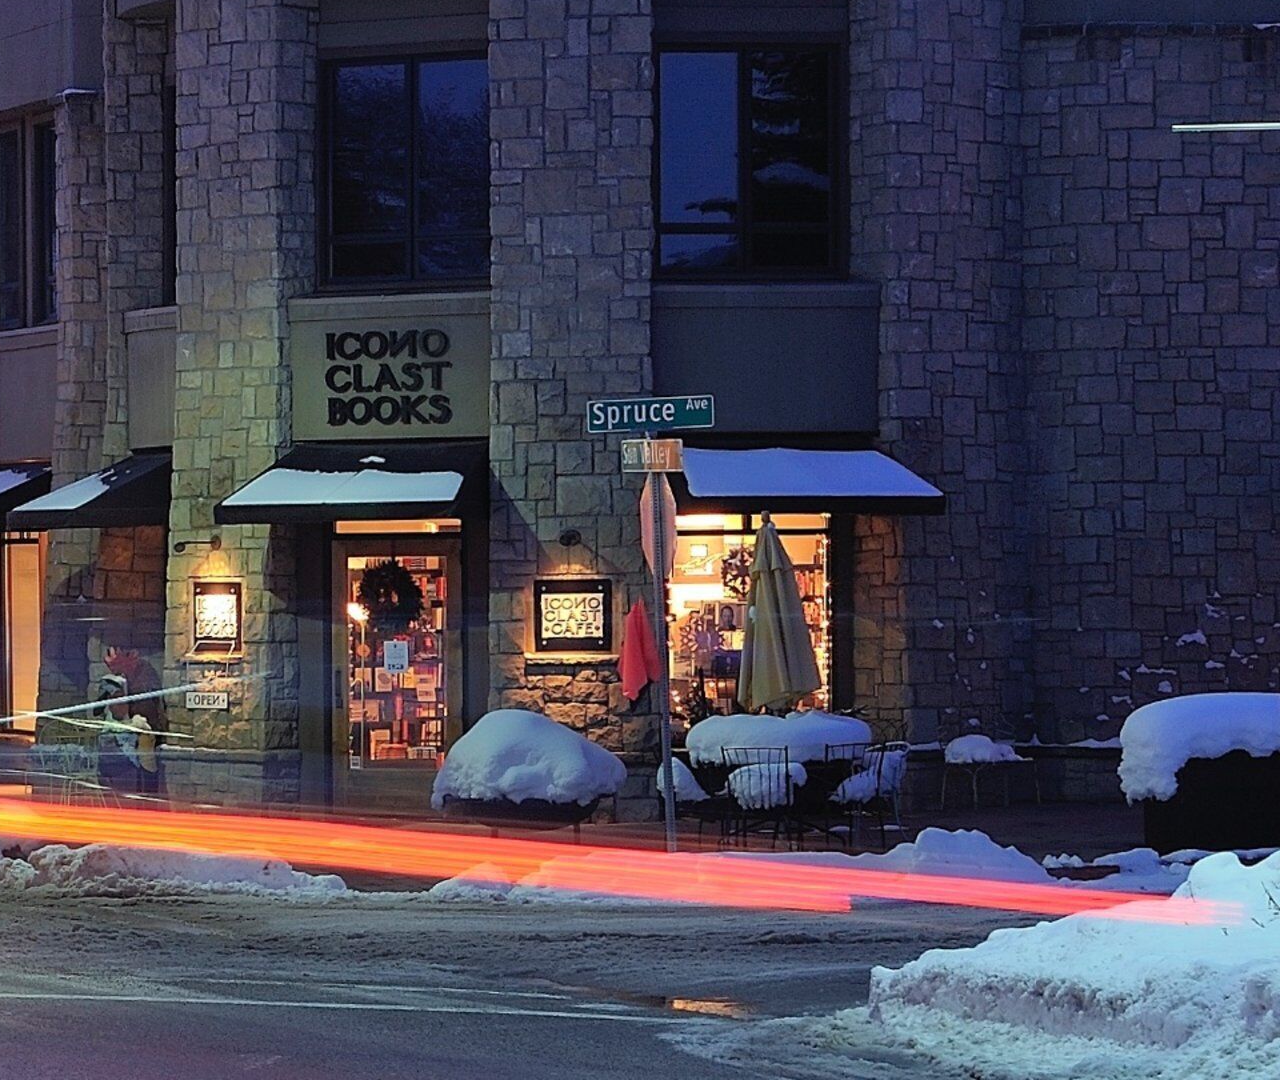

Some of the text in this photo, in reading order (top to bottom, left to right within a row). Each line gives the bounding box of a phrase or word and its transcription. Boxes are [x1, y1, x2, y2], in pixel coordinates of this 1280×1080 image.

[325, 329, 451, 361] ICONO
[325, 361, 453, 393] CLAST
[326, 394, 454, 427] BOOKS
[592, 398, 709, 430] Spruce Ave
[640, 440, 672, 470] Valley
[544, 610, 601, 622] CLAST
[551, 623, 594, 635] CAFE
[193, 694, 220, 706] OPEN
